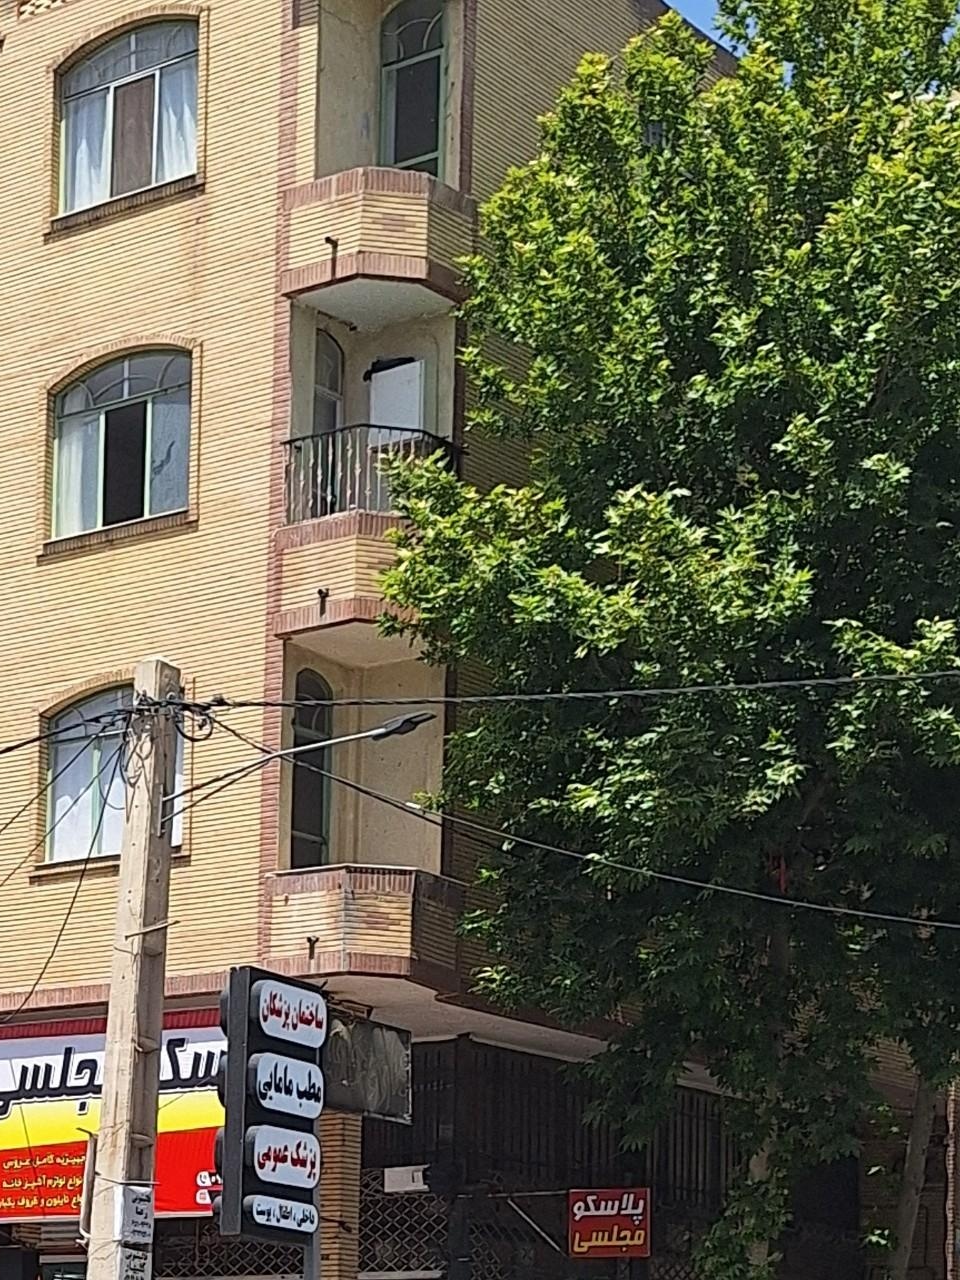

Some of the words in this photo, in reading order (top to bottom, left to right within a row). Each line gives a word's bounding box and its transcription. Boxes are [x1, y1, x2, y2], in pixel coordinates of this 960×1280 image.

[262, 990, 290, 1031] پزشکان
[292, 999, 324, 1031] ساختمان
[259, 1062, 294, 1101] مامایی
[296, 1069, 322, 1108] مطب
[257, 1144, 289, 1172] عمومی
[290, 1140, 317, 1180] پزشک
[67, 1176, 83, 1190] نواع
[573, 1193, 645, 1225] پلاسکو
[573, 1225, 645, 1253] مجلسی
